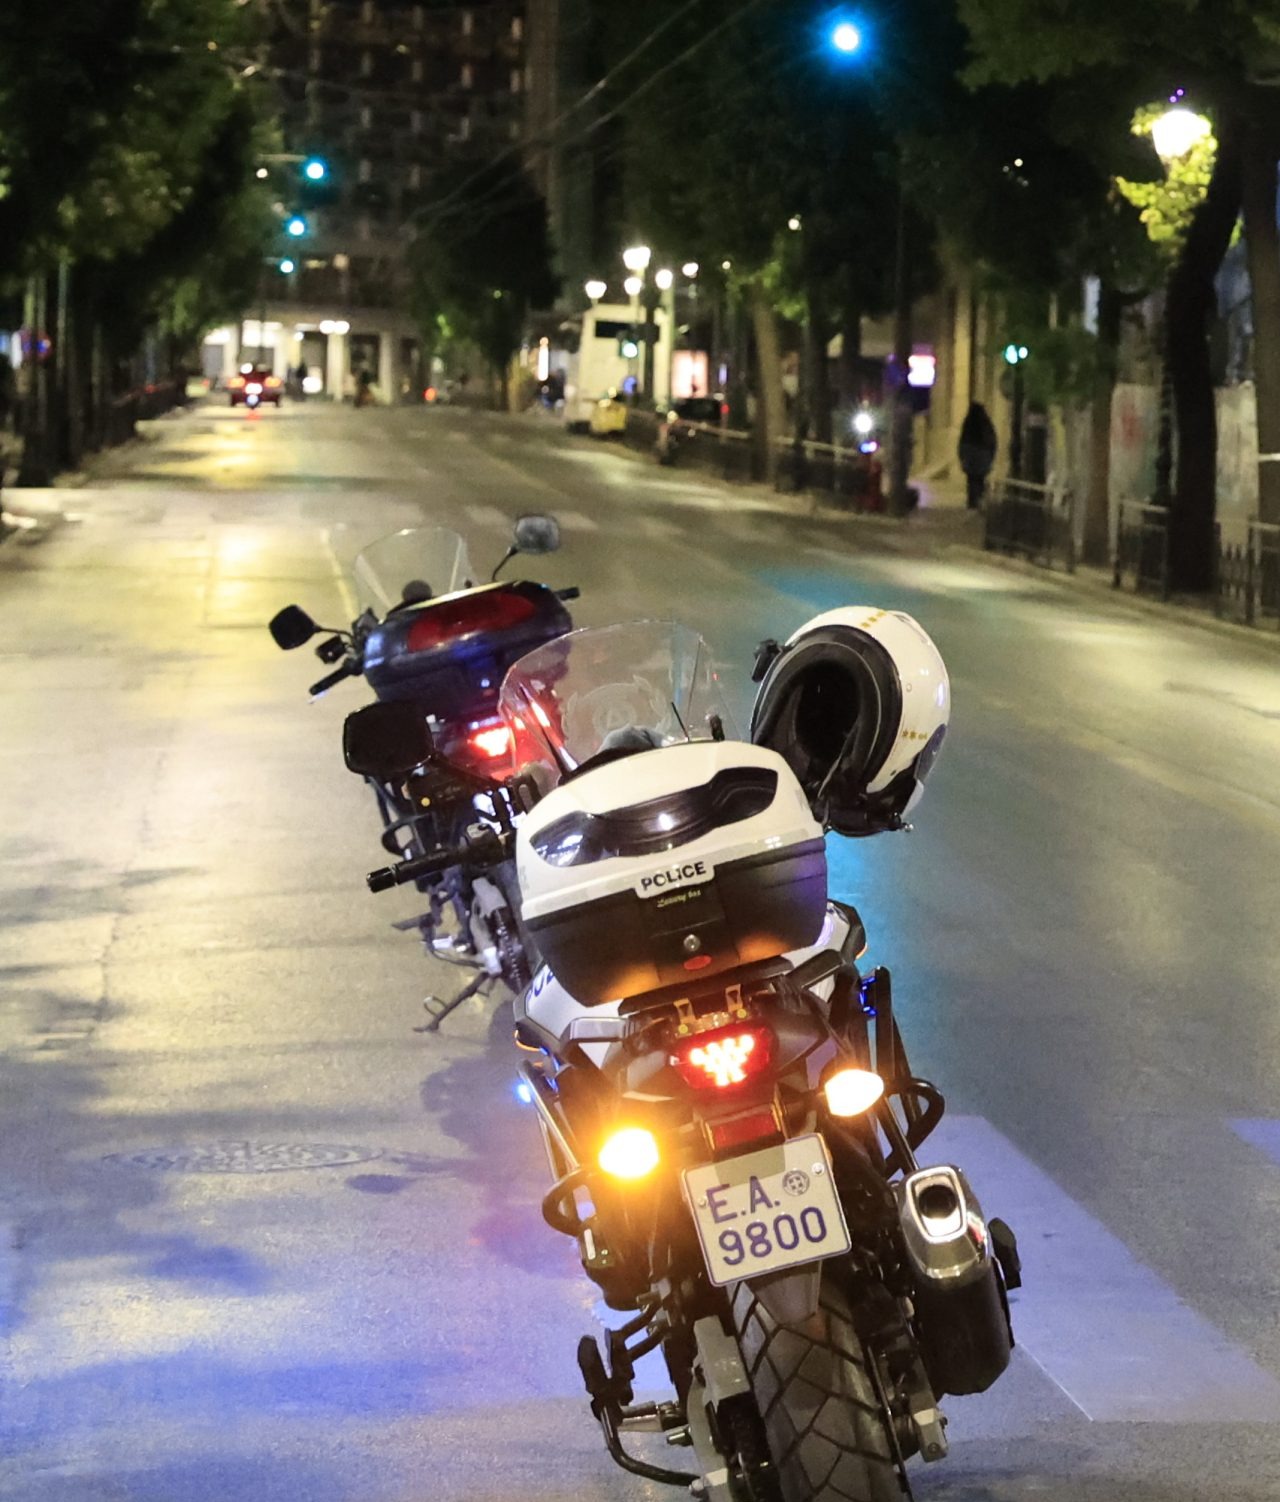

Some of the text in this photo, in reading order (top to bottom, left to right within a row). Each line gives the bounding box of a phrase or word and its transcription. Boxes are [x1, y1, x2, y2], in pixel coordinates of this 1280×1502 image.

[640, 861, 707, 891] POLICE
[705, 1175, 780, 1223] E.A.
[718, 1206, 827, 1265] 9800
